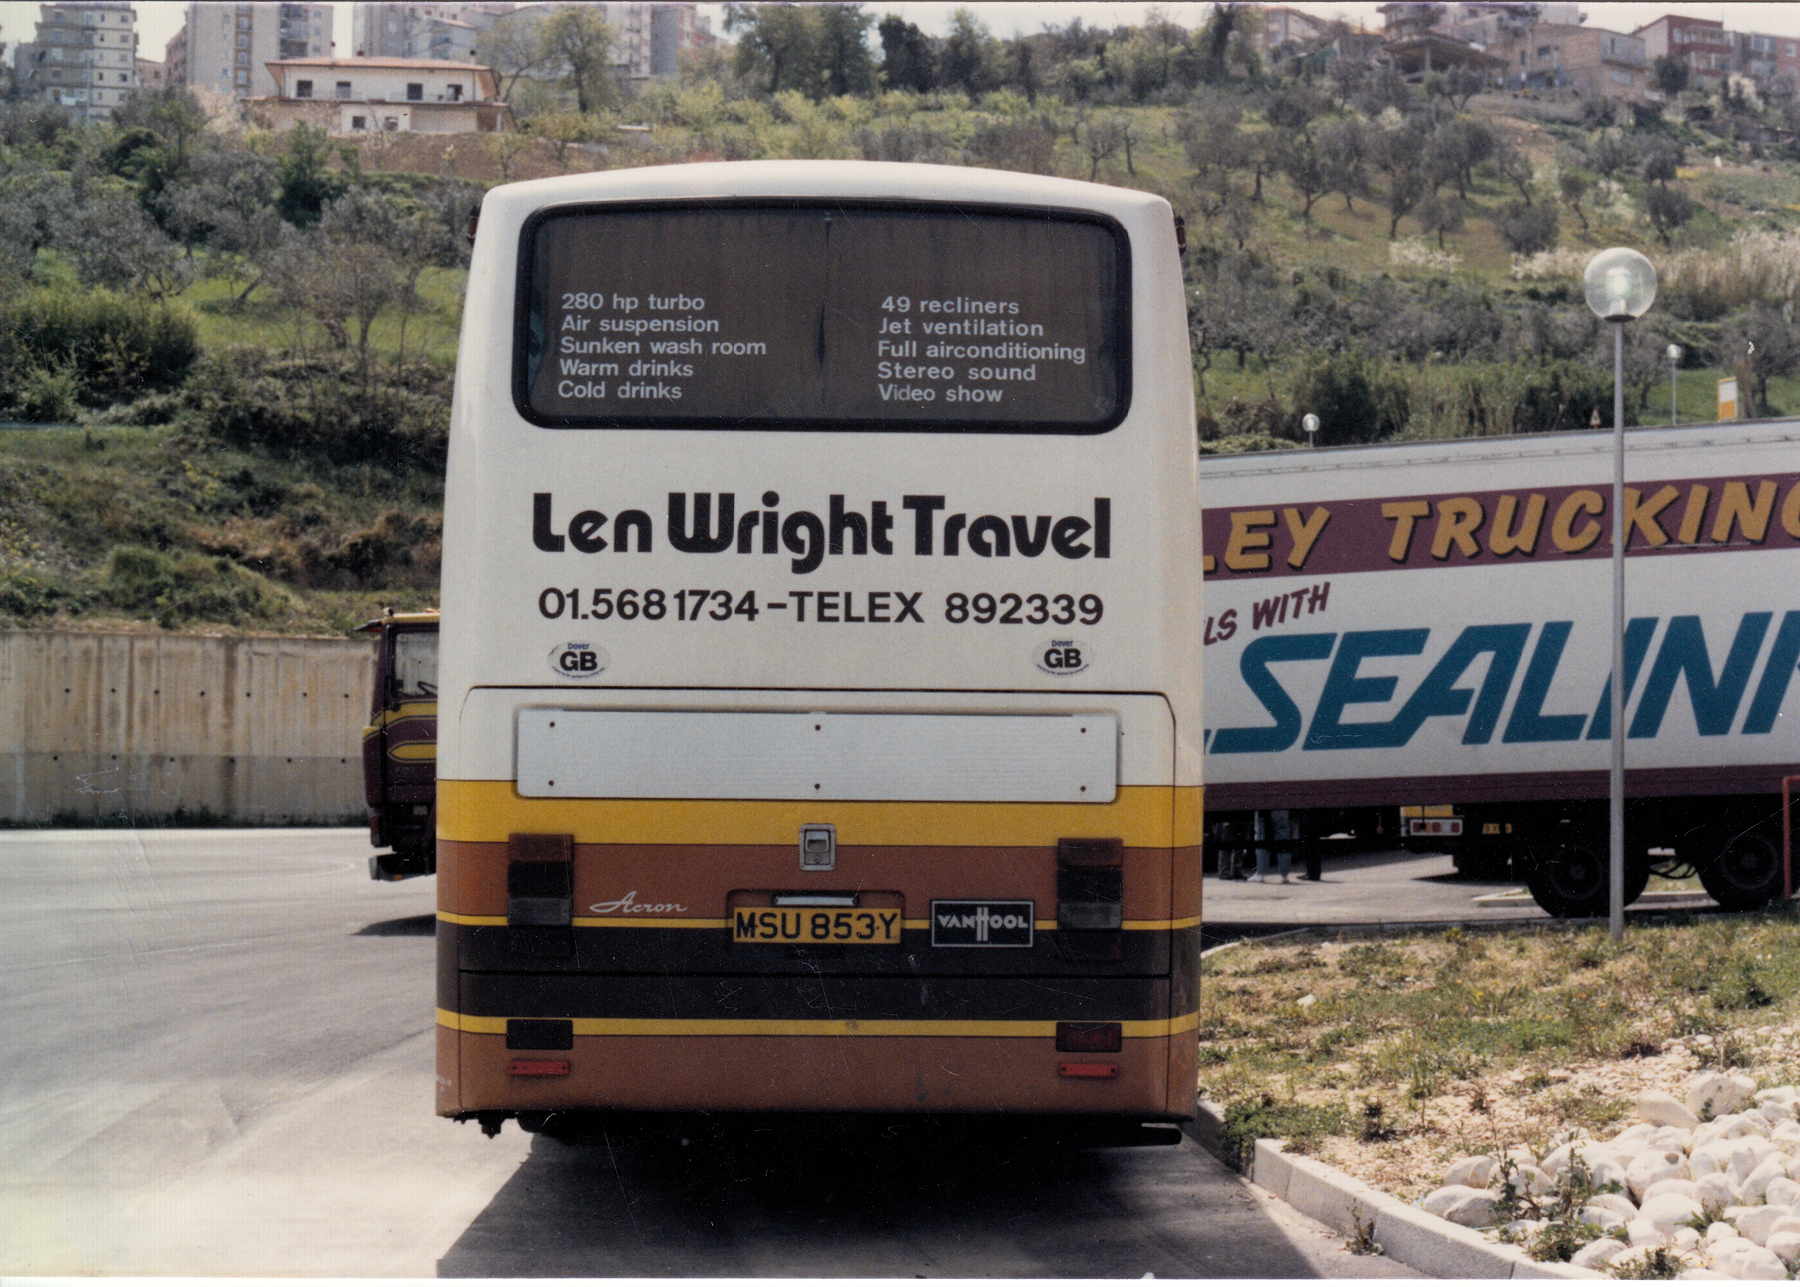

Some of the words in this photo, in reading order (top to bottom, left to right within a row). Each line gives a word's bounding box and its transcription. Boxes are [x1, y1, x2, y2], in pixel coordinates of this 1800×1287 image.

[561, 292, 604, 310] 280
[612, 293, 639, 314] hp
[648, 294, 705, 311] turbo
[880, 295, 911, 313] 49
[919, 296, 1020, 315] recliners
[561, 314, 591, 332] Air
[599, 316, 720, 336] suspension
[878, 317, 912, 335] Jet
[922, 318, 1044, 337] ventilation
[560, 336, 641, 354] Sunken
[649, 337, 703, 355] wash
[712, 340, 767, 356] room
[877, 340, 918, 358] Full
[925, 341, 1086, 365] airconditioning
[559, 358, 619, 377] Warm
[628, 359, 694, 377] drinks
[877, 361, 955, 380] Stereo
[967, 364, 1036, 381] sound
[557, 379, 606, 399] Cold
[617, 381, 683, 400] drinks
[878, 383, 936, 402] Video
[945, 384, 1003, 402] show
[532, 492, 652, 553] Len
[667, 490, 893, 575] Wright
[902, 495, 1111, 559] Travel
[944, 592, 1104, 625] 892339
[1252, 581, 1331, 631] WITH
[560, 650, 598, 672] GB
[1044, 647, 1082, 669] GB
[735, 911, 800, 939] MSU
[810, 911, 898, 940] 853Y
